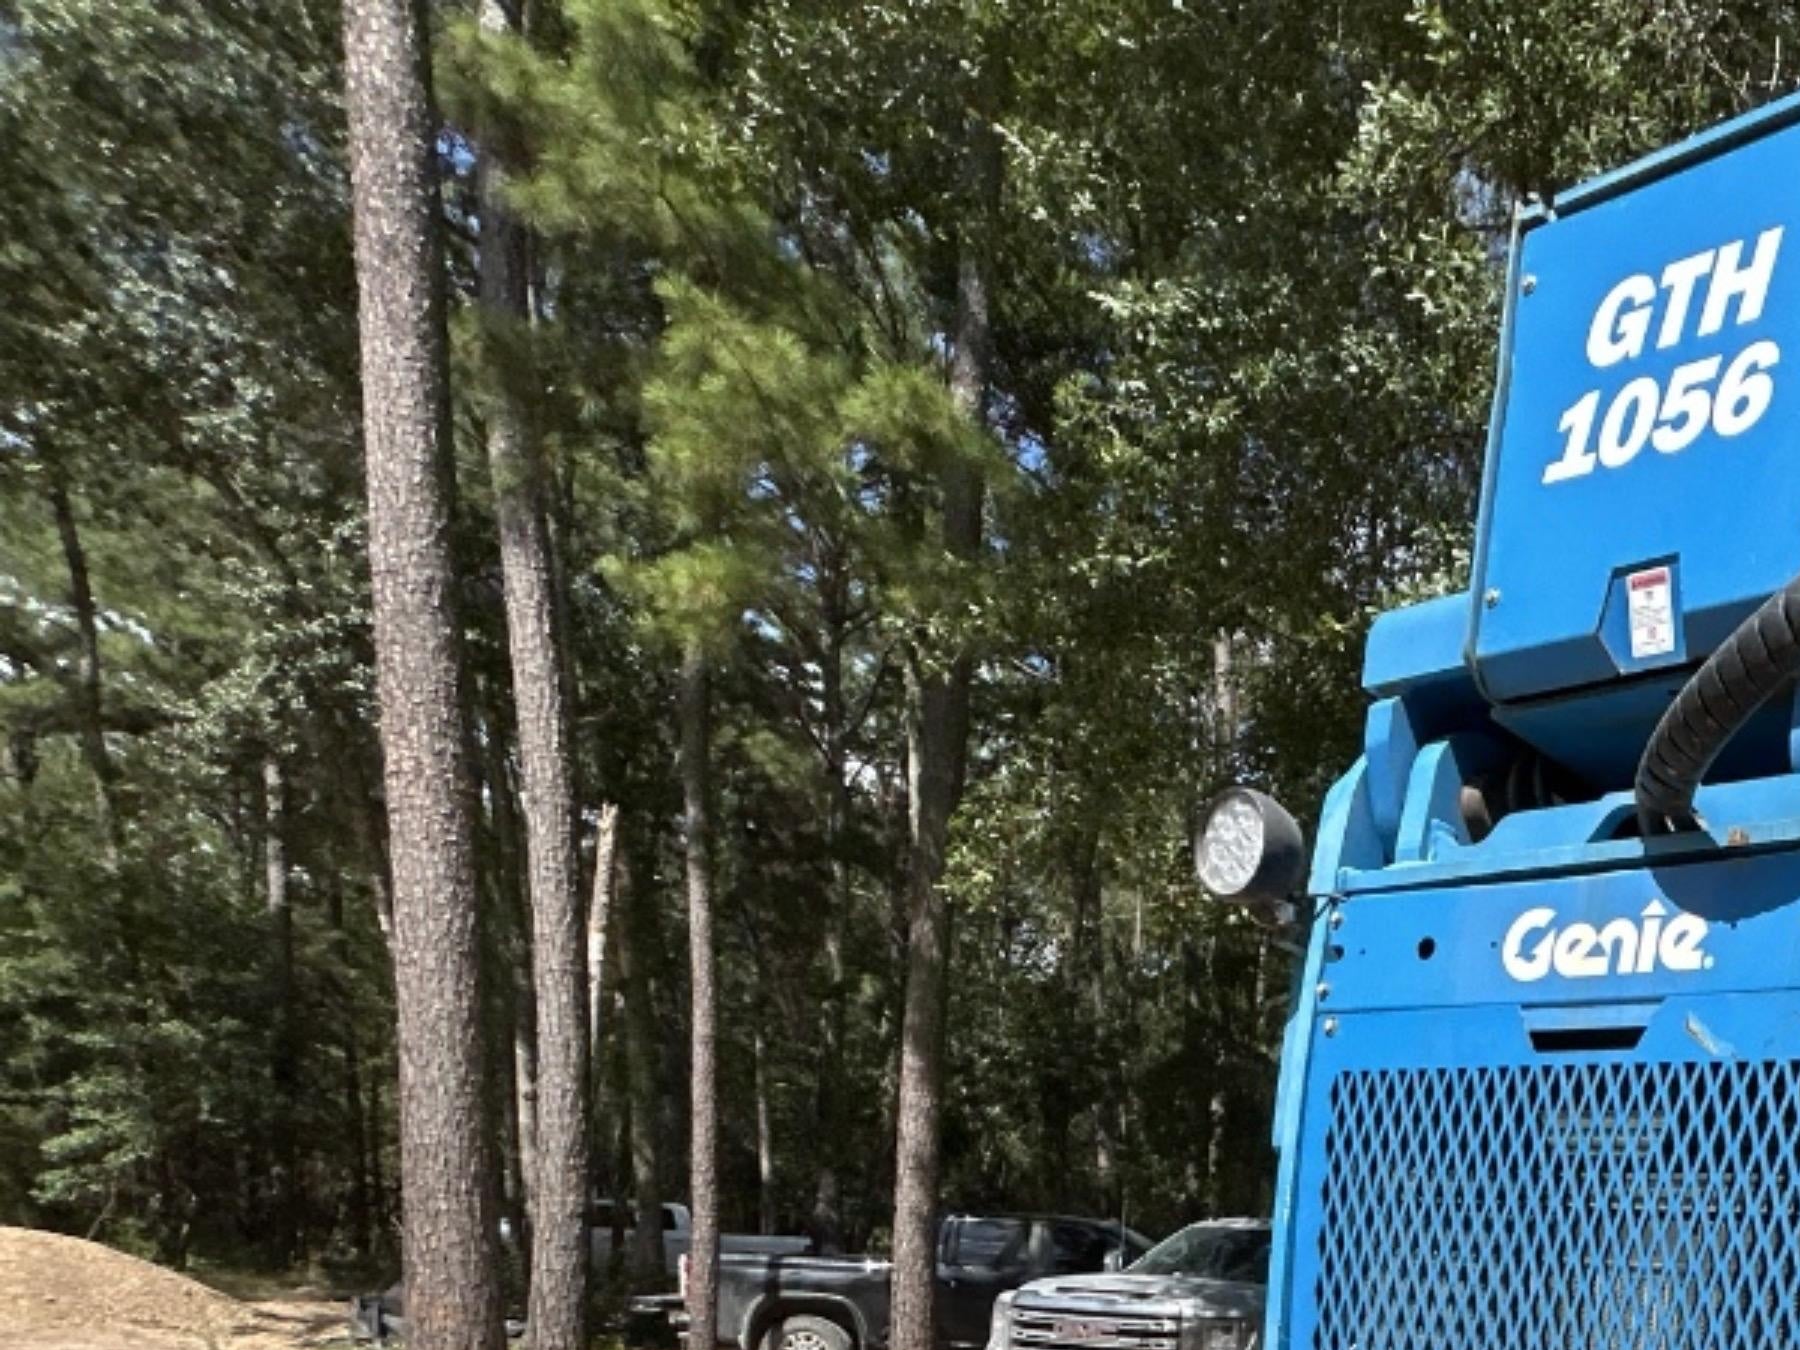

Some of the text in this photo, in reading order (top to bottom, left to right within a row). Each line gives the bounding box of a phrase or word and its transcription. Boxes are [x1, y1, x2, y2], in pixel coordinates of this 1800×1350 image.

[1585, 225, 1785, 369] GTH
[1541, 340, 1781, 484] 1056
[1502, 898, 1710, 982] Genie
